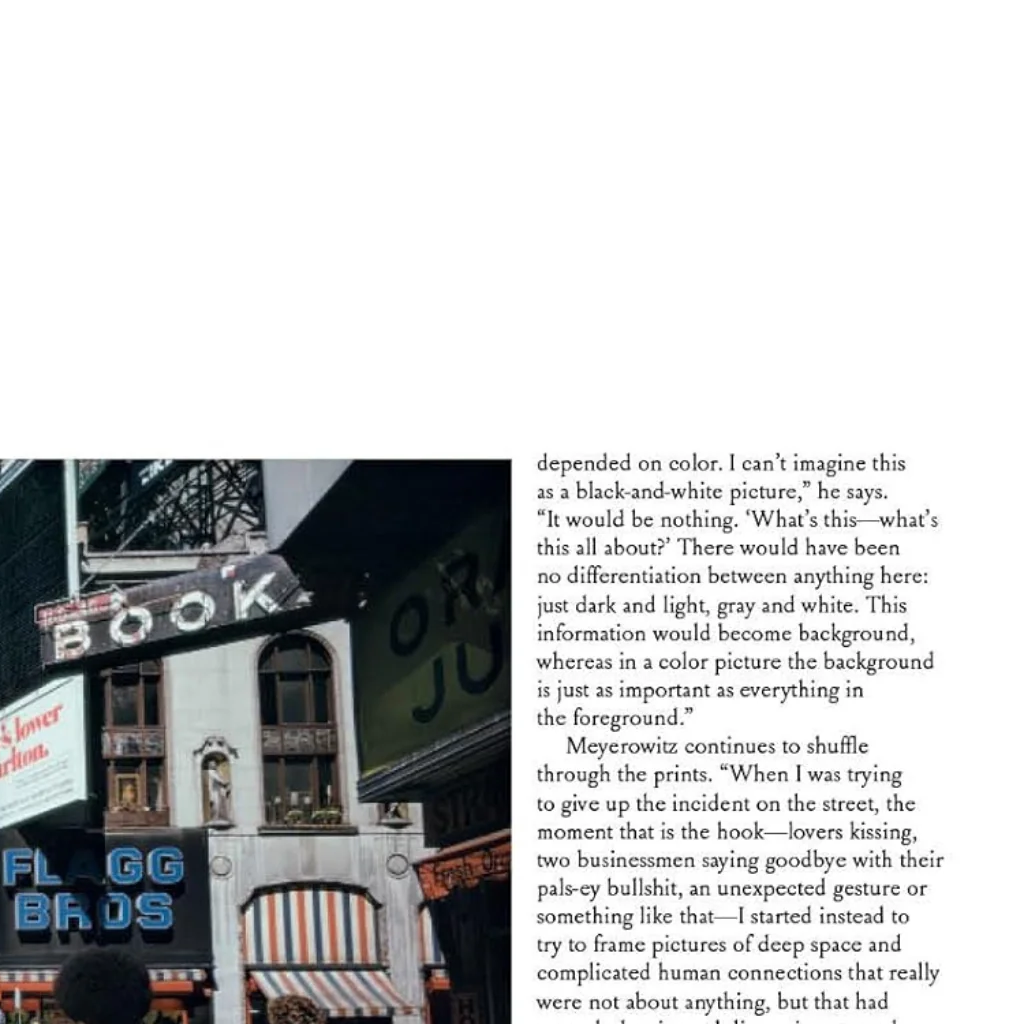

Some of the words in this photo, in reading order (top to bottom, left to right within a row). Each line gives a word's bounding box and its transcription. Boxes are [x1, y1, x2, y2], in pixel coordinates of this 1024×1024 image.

[537, 572, 561, 584] no
[567, 564, 701, 584] differentiation
[707, 564, 787, 584] between
[793, 565, 874, 591] anything
[880, 564, 928, 584] here:
[537, 622, 646, 642] information
[652, 622, 711, 642] would
[717, 622, 792, 642] become
[798, 622, 915, 648] background,
[536, 650, 613, 670] whereas
[619, 651, 637, 670] in
[643, 658, 653, 670] a
[658, 650, 709, 670] color
[714, 651, 782, 676] picture
[788, 650, 818, 670] the
[823, 650, 934, 676] background
[15, 704, 64, 743] lower
[567, 735, 678, 761] Meyerowitz
[684, 735, 776, 755] continues
[782, 740, 801, 755] to
[806, 735, 869, 755] shuffle
[3, 846, 185, 886] FLAGG
[537, 854, 571, 868] two
[577, 849, 696, 868] businessmen
[702, 849, 760, 875] saying
[765, 849, 847, 875] goodbye
[852, 849, 893, 868] with
[900, 849, 945, 868] their
[537, 877, 601, 903] pals-ey
[607, 877, 683, 899] bullshit,
[689, 884, 711, 897] an
[717, 877, 826, 903] unexpected
[832, 882, 901, 903] gesture
[907, 884, 928, 897] or
[14, 892, 174, 931] BROS
[537, 961, 650, 987] complicated
[658, 961, 721, 981] human
[727, 962, 842, 981] connections
[848, 961, 883, 981] that
[889, 961, 940, 987] really
